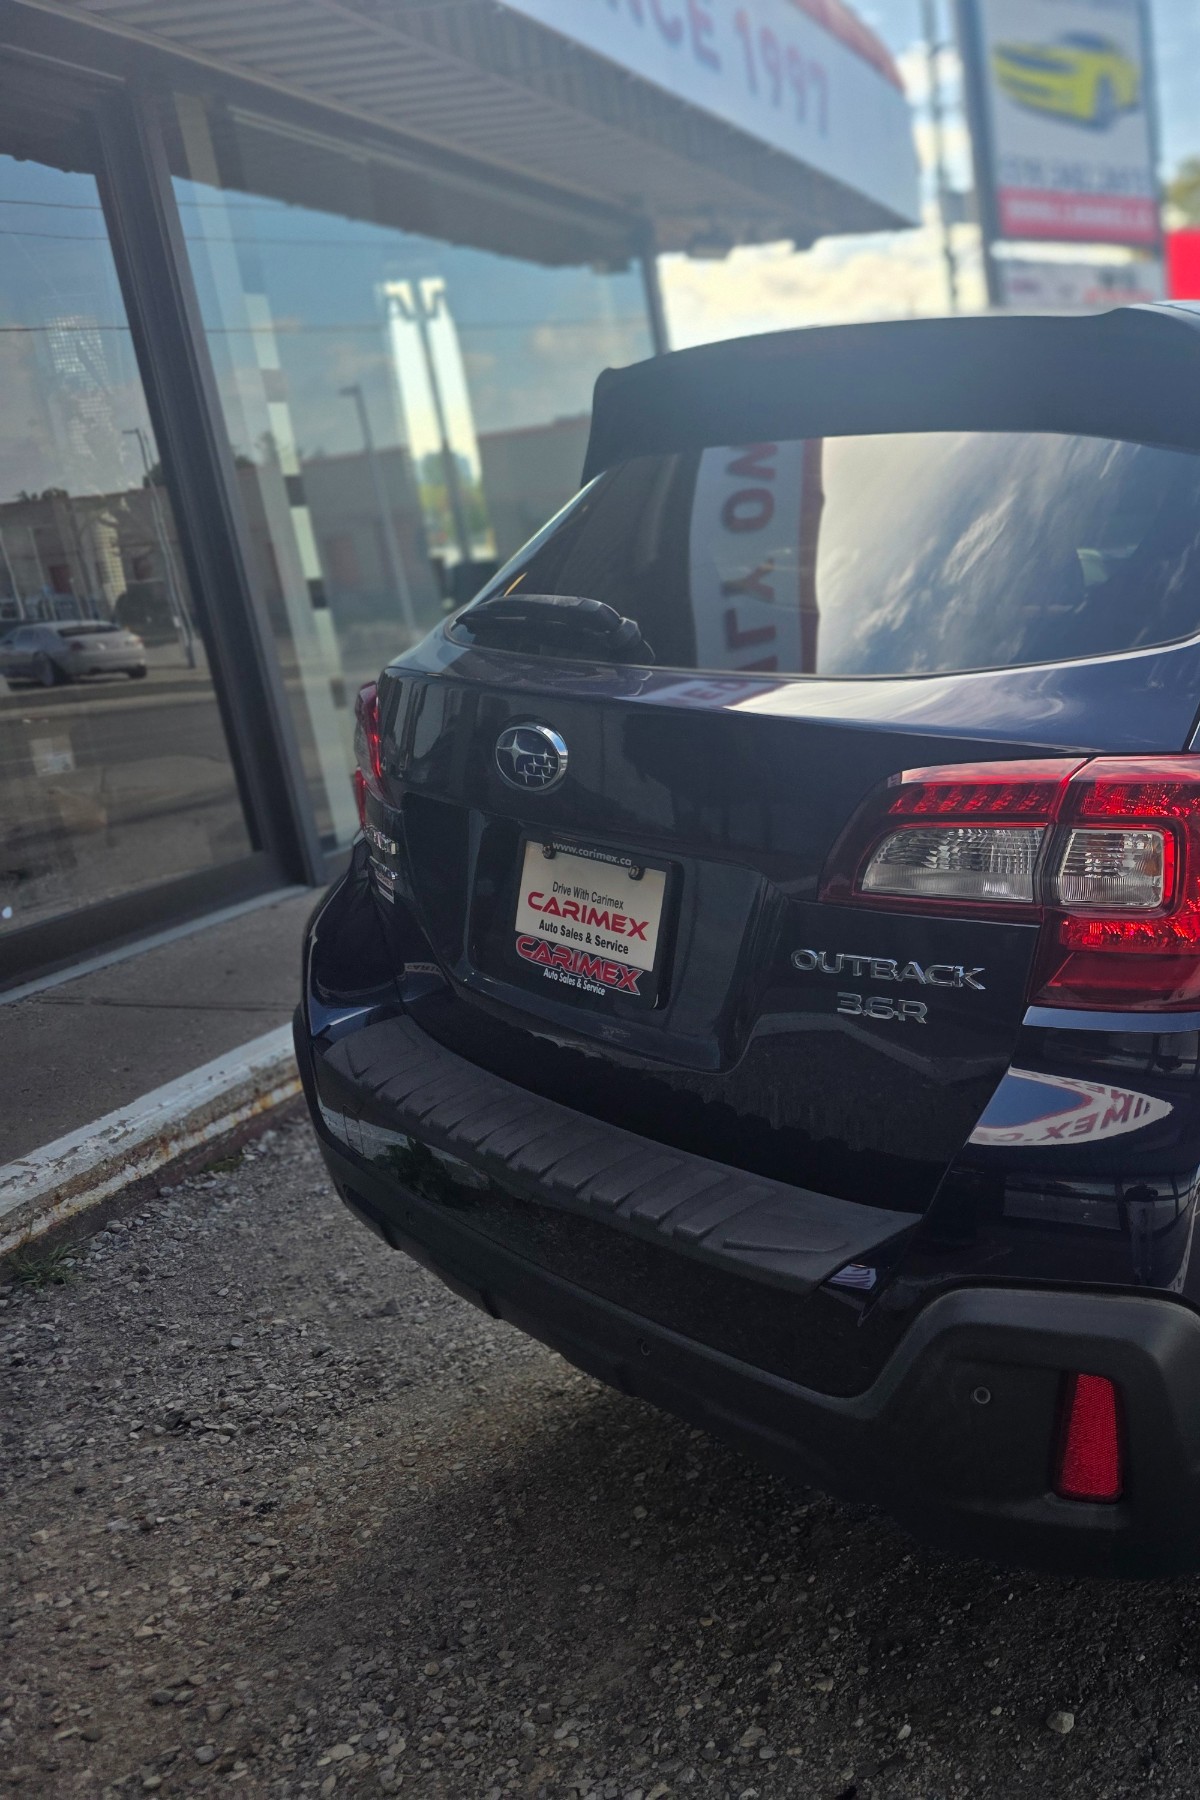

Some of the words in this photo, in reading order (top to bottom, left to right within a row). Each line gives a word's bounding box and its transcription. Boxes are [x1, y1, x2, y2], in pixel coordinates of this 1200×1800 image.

[732, 5, 830, 138] 1997
[552, 841, 632, 866] www.carimex.ca
[552, 881, 572, 896] Drive
[573, 886, 590, 901] With
[591, 891, 624, 911] Carimex
[527, 891, 650, 942] CARIMEX
[538, 919, 559, 934] Auto
[559, 925, 584, 942] Sales
[585, 932, 593, 944] &
[594, 934, 629, 955] Service
[516, 935, 642, 994] CARIMEX
[543, 968, 558, 981] Auto
[559, 972, 576, 987] Sales
[576, 978, 582, 988] &
[582, 980, 606, 996] Service
[790, 949, 986, 990] OUTBACK
